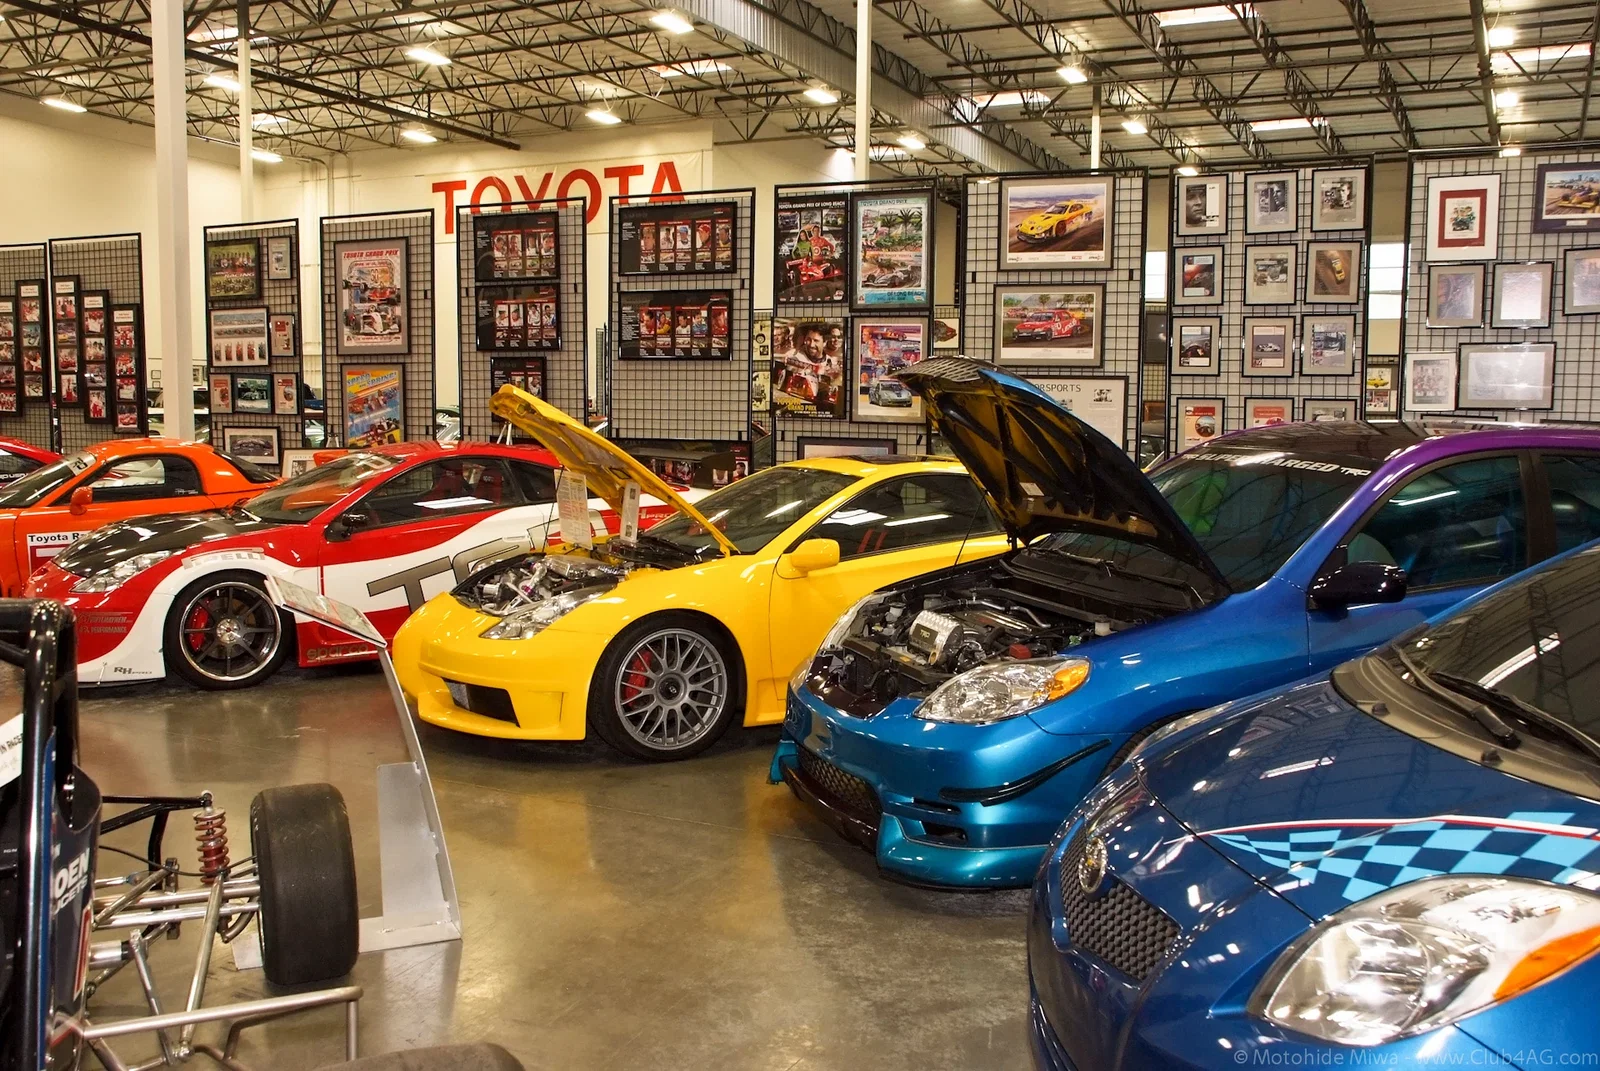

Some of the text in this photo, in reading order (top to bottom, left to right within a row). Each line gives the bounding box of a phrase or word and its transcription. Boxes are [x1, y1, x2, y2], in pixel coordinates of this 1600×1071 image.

[432, 161, 685, 234] TOYOTA
[1196, 453, 1340, 473] SUPEHARGED
[29, 534, 69, 543] Toyota
[307, 644, 368, 660] sparco
